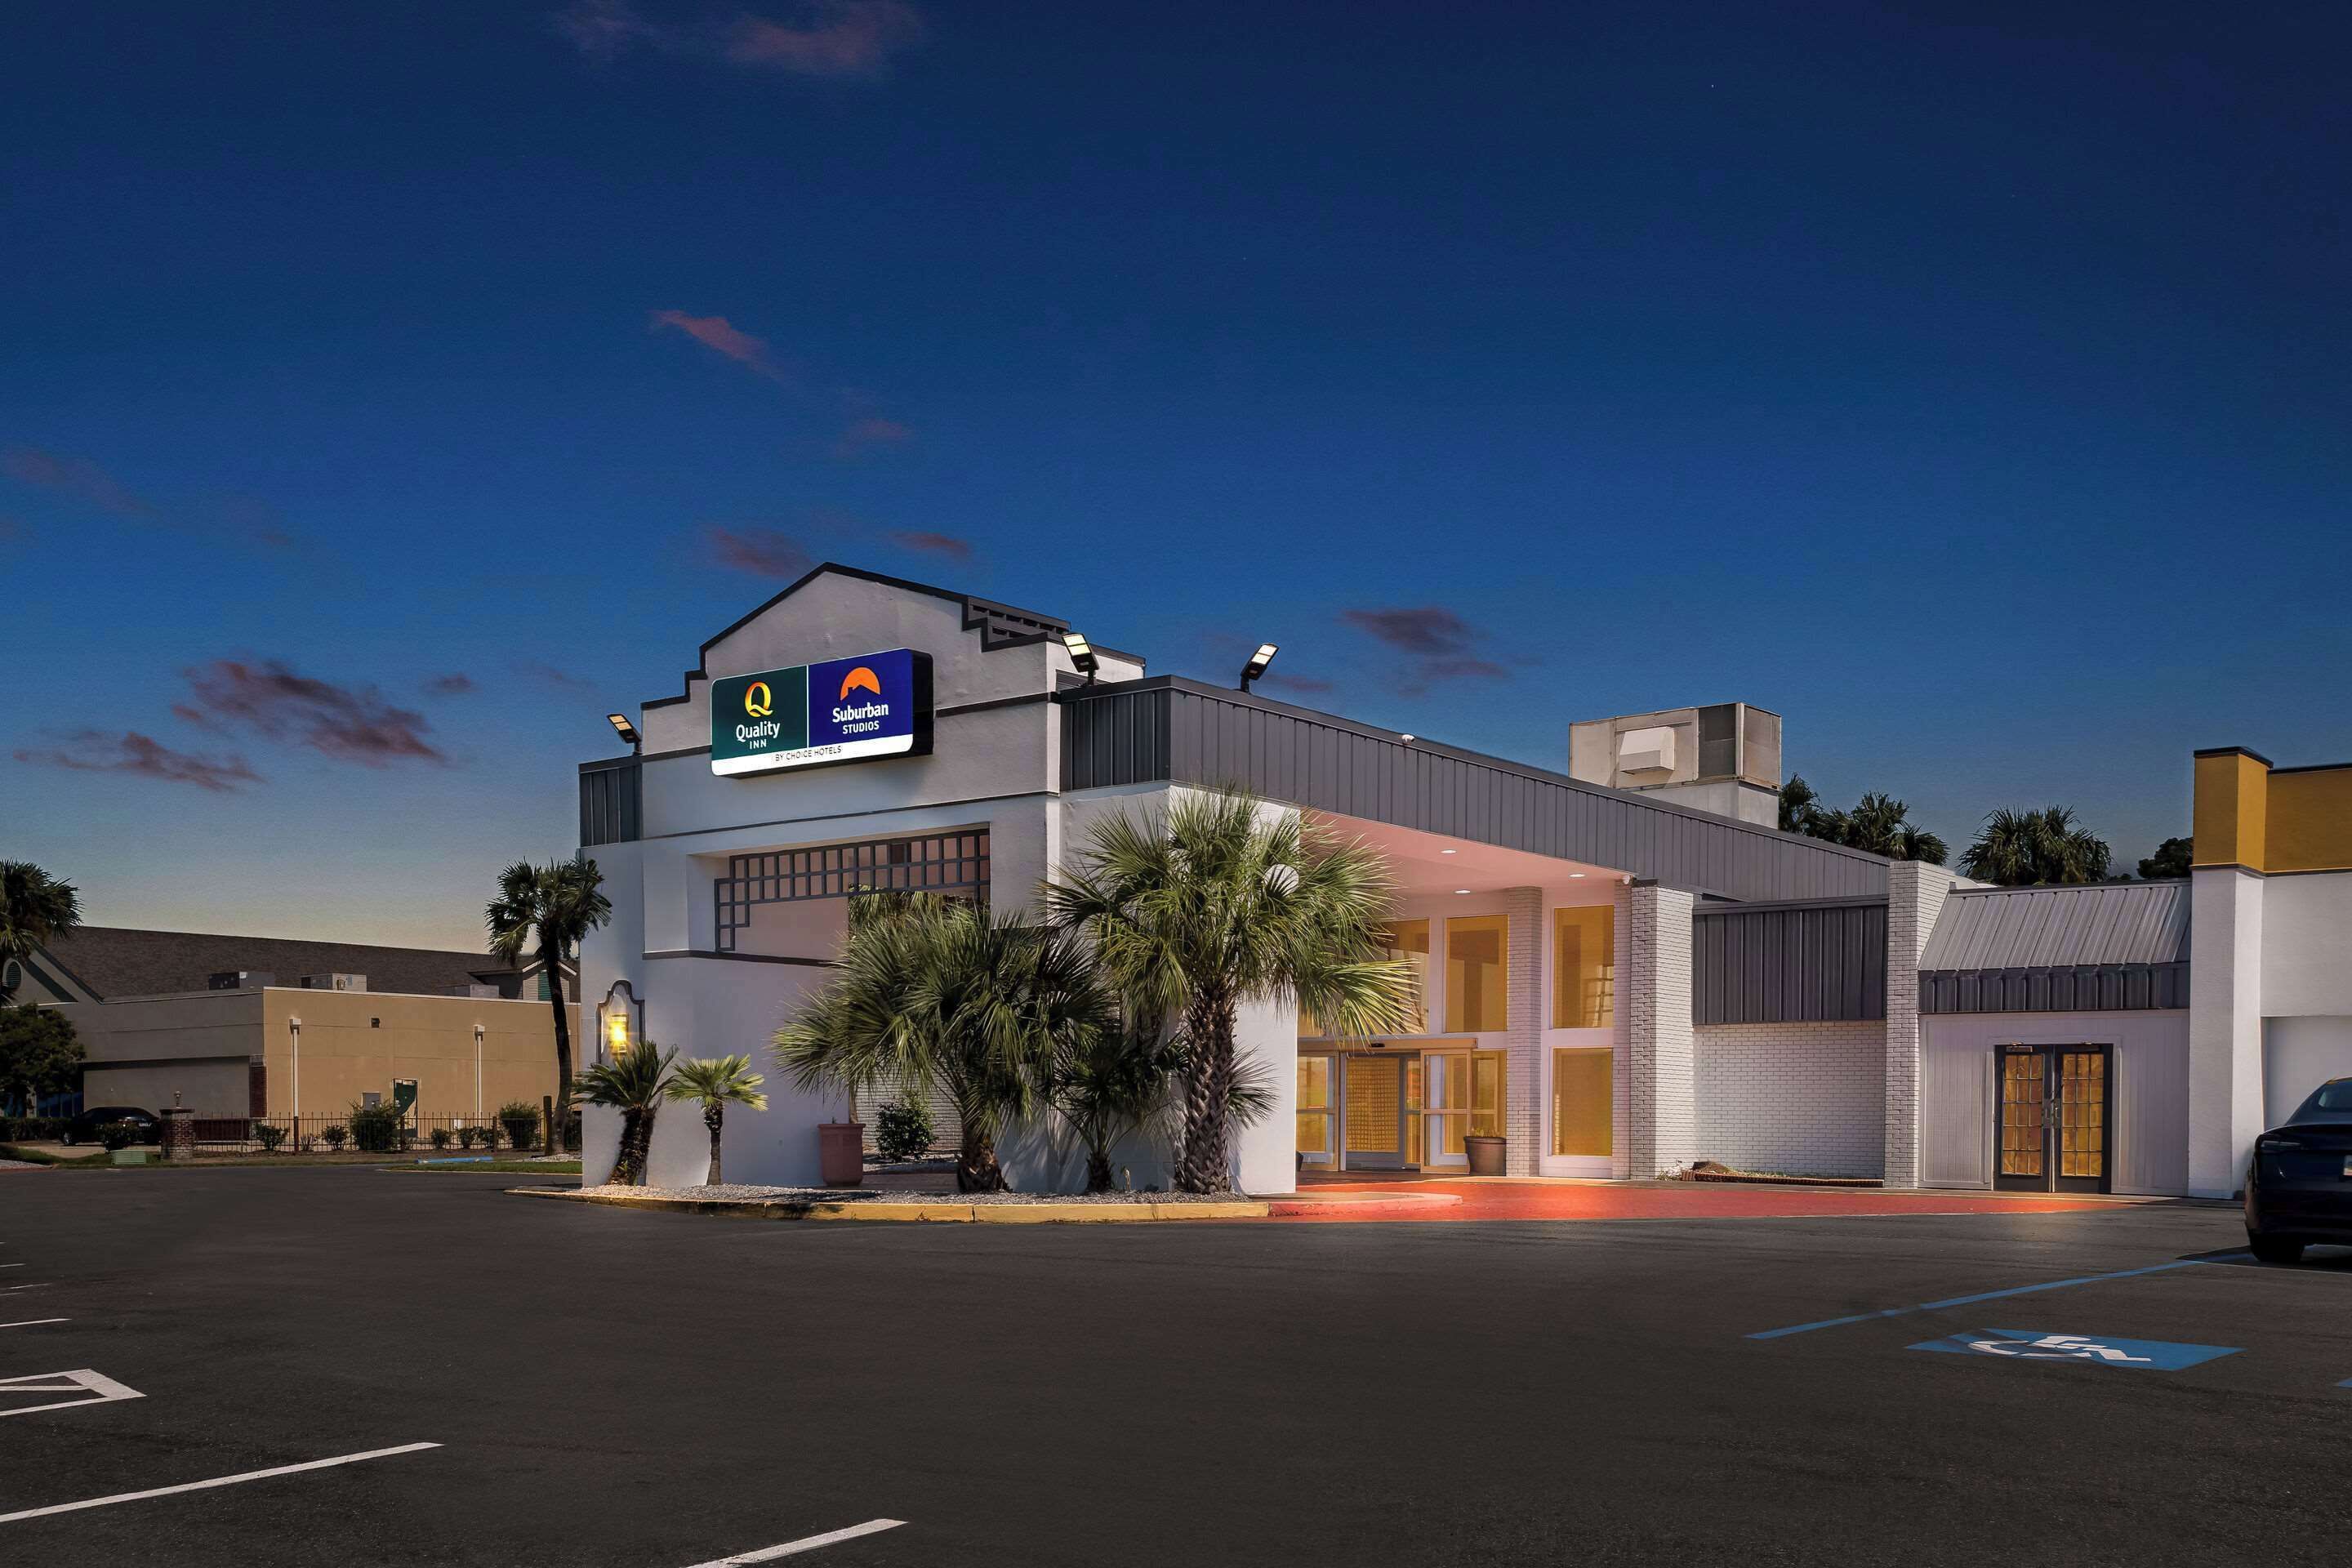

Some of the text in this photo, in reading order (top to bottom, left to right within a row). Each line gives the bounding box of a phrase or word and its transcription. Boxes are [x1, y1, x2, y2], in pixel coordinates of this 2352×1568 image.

[745, 681, 774, 717] Q
[832, 702, 889, 723] Suburban
[736, 721, 781, 742] Quality
[843, 720, 880, 734] STUDIOS
[750, 739, 767, 750] INN
[786, 750, 812, 760] CHOICE
[815, 746, 841, 756] HOTELS
